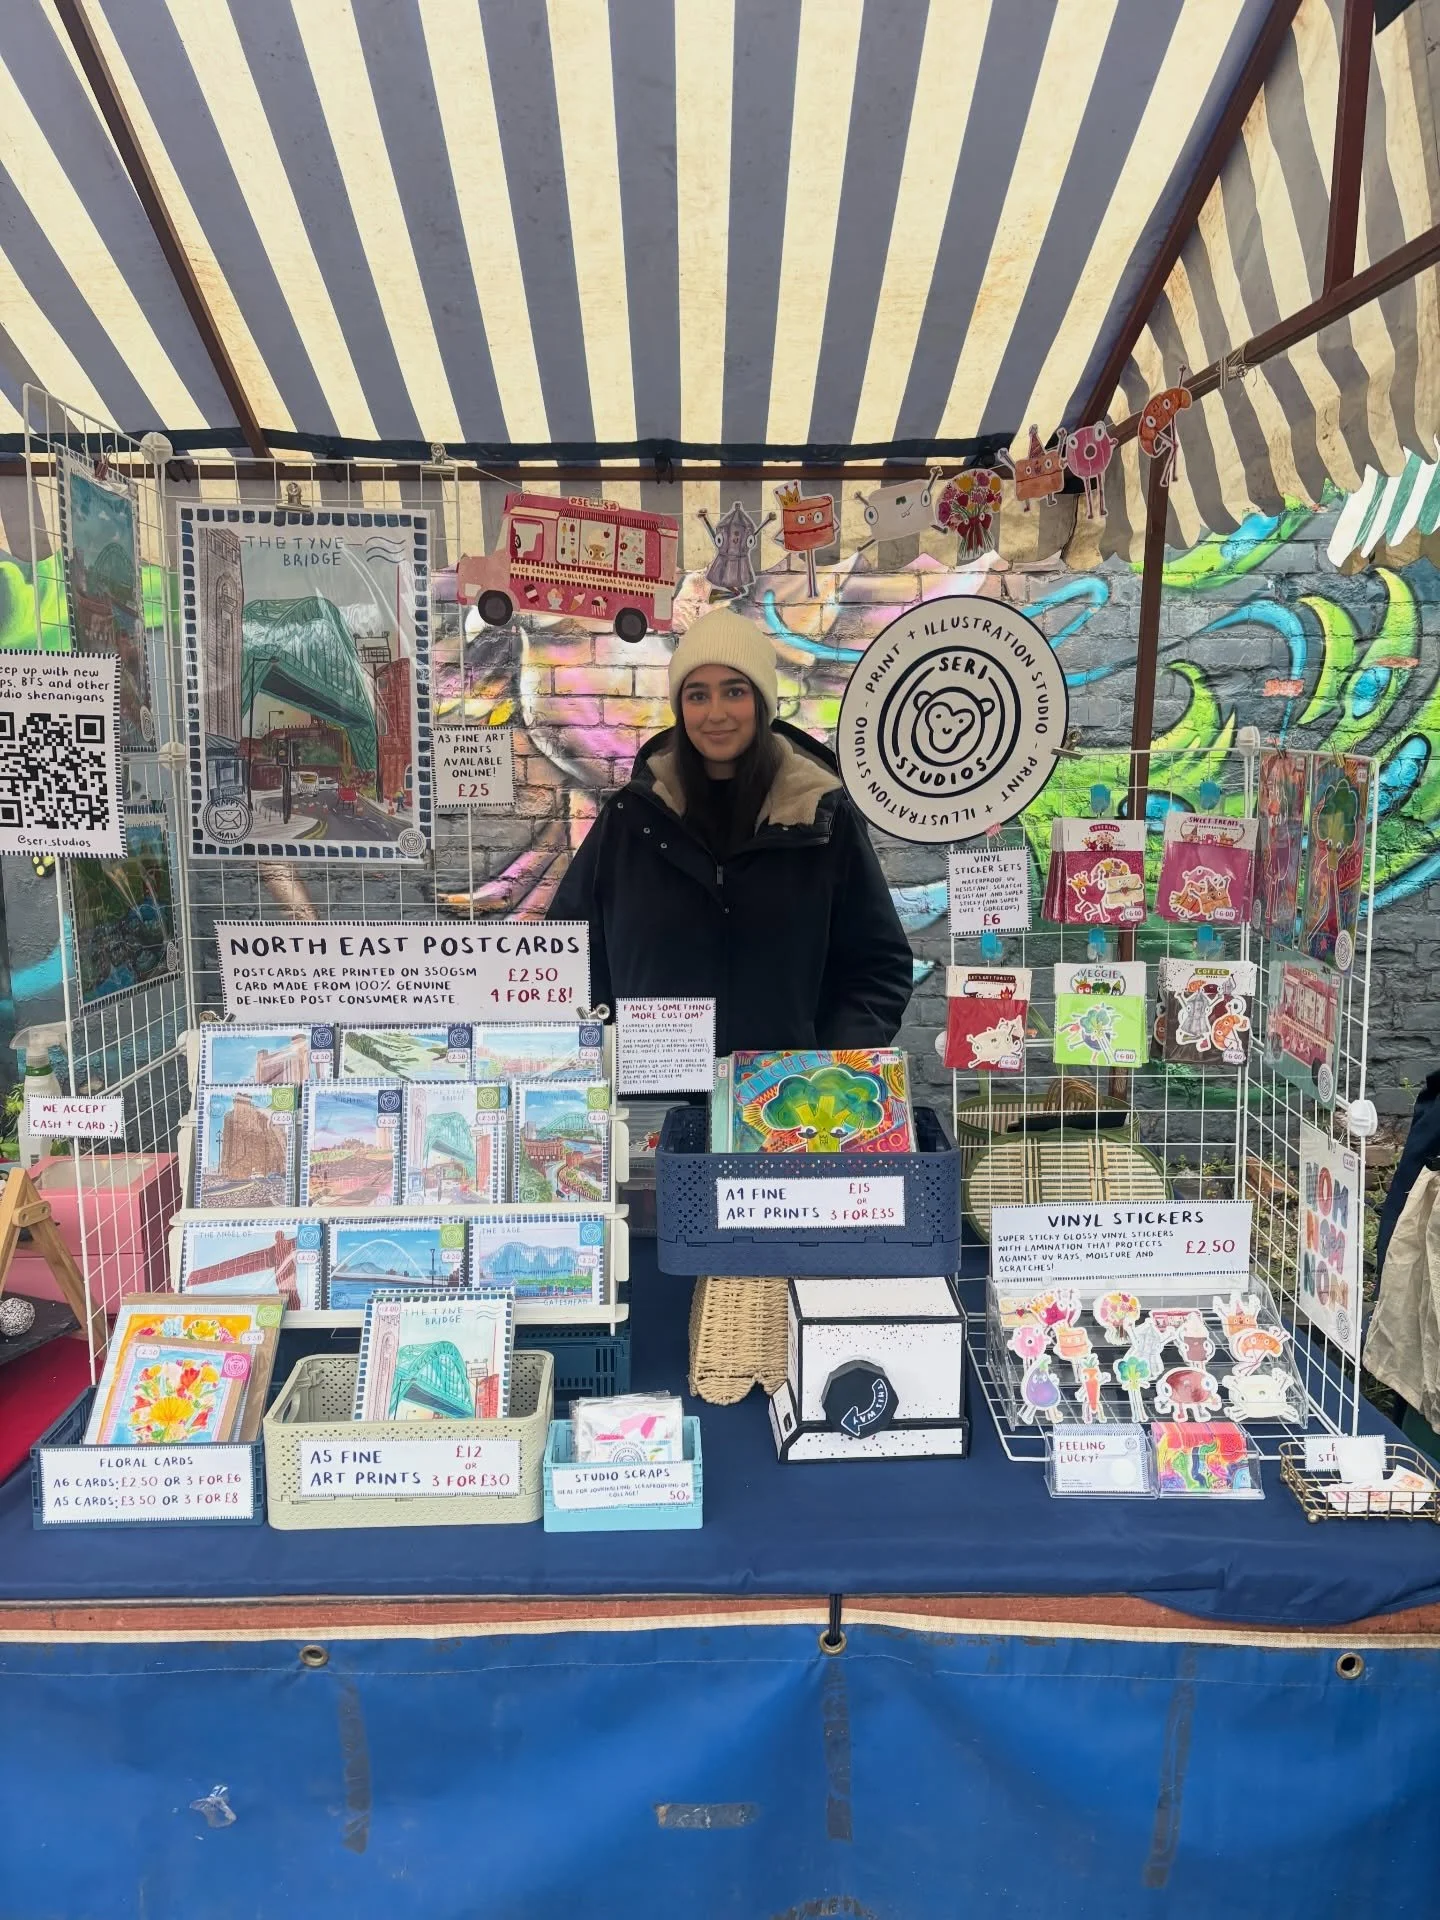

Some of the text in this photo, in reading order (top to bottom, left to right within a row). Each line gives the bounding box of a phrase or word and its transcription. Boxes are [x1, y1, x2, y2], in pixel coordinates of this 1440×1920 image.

[245, 536, 344, 550] THE TYNE
[283, 552, 341, 567] BRIDGE
[532, 568, 559, 577] CREAMS
[23, 666, 99, 677] up with new
[938, 656, 990, 680] SERI
[865, 616, 1049, 735] PRINT ILLUSTRATION STUDIO
[21, 677, 110, 691] BTS and other
[27, 691, 105, 703] shenanigans
[438, 733, 505, 744] A3 FINE ART
[453, 745, 492, 754] PRINTS
[443, 757, 503, 767] AVAILABLE
[452, 767, 496, 778] ONLINE!
[855, 717, 1038, 827] PRINT ILLUSTRATION STUDIO
[896, 756, 989, 787] STUDIOS
[458, 783, 489, 798] £25
[17, 834, 91, 848] @seri_studios
[973, 854, 1002, 863] VINYL
[955, 863, 1022, 875] STICKER SETS
[954, 892, 987, 900] RESISTANT
[983, 913, 1001, 926] £6
[230, 936, 580, 957] NORTH EAST POSTCARDS
[233, 966, 477, 978] POSTCARDS ARE PRINTED ON 350GSM
[508, 967, 558, 983] £2.50
[1080, 968, 1118, 979] VEGGIE
[235, 980, 451, 991] CARD MADE FROM 100% GENUINE
[236, 995, 295, 1005] DE-INKED
[300, 994, 331, 1004] POST
[338, 994, 408, 1005] CONSUMER
[490, 987, 573, 1003] 4 FOR £8!
[623, 1003, 712, 1012] FANCY SOMETHING
[631, 1011, 704, 1020] MORE CUSTOM?
[735, 1052, 833, 1104] KITCHEN
[43, 1104, 108, 1114] WE ACCEPT
[32, 1119, 61, 1129] CASH
[77, 1121, 105, 1130] CARD
[752, 1187, 787, 1200] FINE
[849, 1182, 870, 1195] £15
[726, 1206, 820, 1220] ART PRINTS
[830, 1207, 895, 1221] 3 FOR £35
[1048, 1210, 1204, 1228] VINYL STICKERS
[998, 1230, 1174, 1242] SUPER STICKY GLOSSY VINYL STICKERS
[998, 1244, 1021, 1252] WITH
[1025, 1242, 1083, 1251] LAMINATION
[1115, 1240, 1163, 1248] PROTECTS
[1185, 1239, 1236, 1256] £2.50
[998, 1254, 1037, 1263] AGAINST
[1085, 1251, 1131, 1260] MOISTURE
[999, 1263, 1055, 1273] SCRATCHES!
[432, 1306, 464, 1315] TYNE
[425, 1315, 461, 1325] BRIDGE
[876, 1384, 885, 1408] THIS
[853, 1411, 876, 1425] WAY
[456, 1445, 482, 1458] £12
[1059, 1441, 1105, 1451] FEELING
[99, 1456, 193, 1468] FLORAL CARDS
[310, 1449, 382, 1464] A5 FINE
[465, 1462, 477, 1470] OR
[53, 1478, 70, 1488] A6
[75, 1477, 119, 1490] CARDS:
[164, 1476, 181, 1487] OR
[186, 1475, 193, 1486] 3
[199, 1474, 223, 1485] FOR
[227, 1473, 241, 1484] £6
[310, 1471, 421, 1487] ART PRINTS
[432, 1474, 510, 1487] 3 FOR £30
[575, 1468, 670, 1483] STUDIO SCRAPS
[53, 1496, 69, 1507] A5
[74, 1495, 119, 1509] CARDS:
[162, 1494, 179, 1505] OR
[184, 1494, 191, 1504] 3
[196, 1493, 221, 1504] FOR
[225, 1492, 239, 1504] £8
[669, 1490, 690, 1501] 50p
